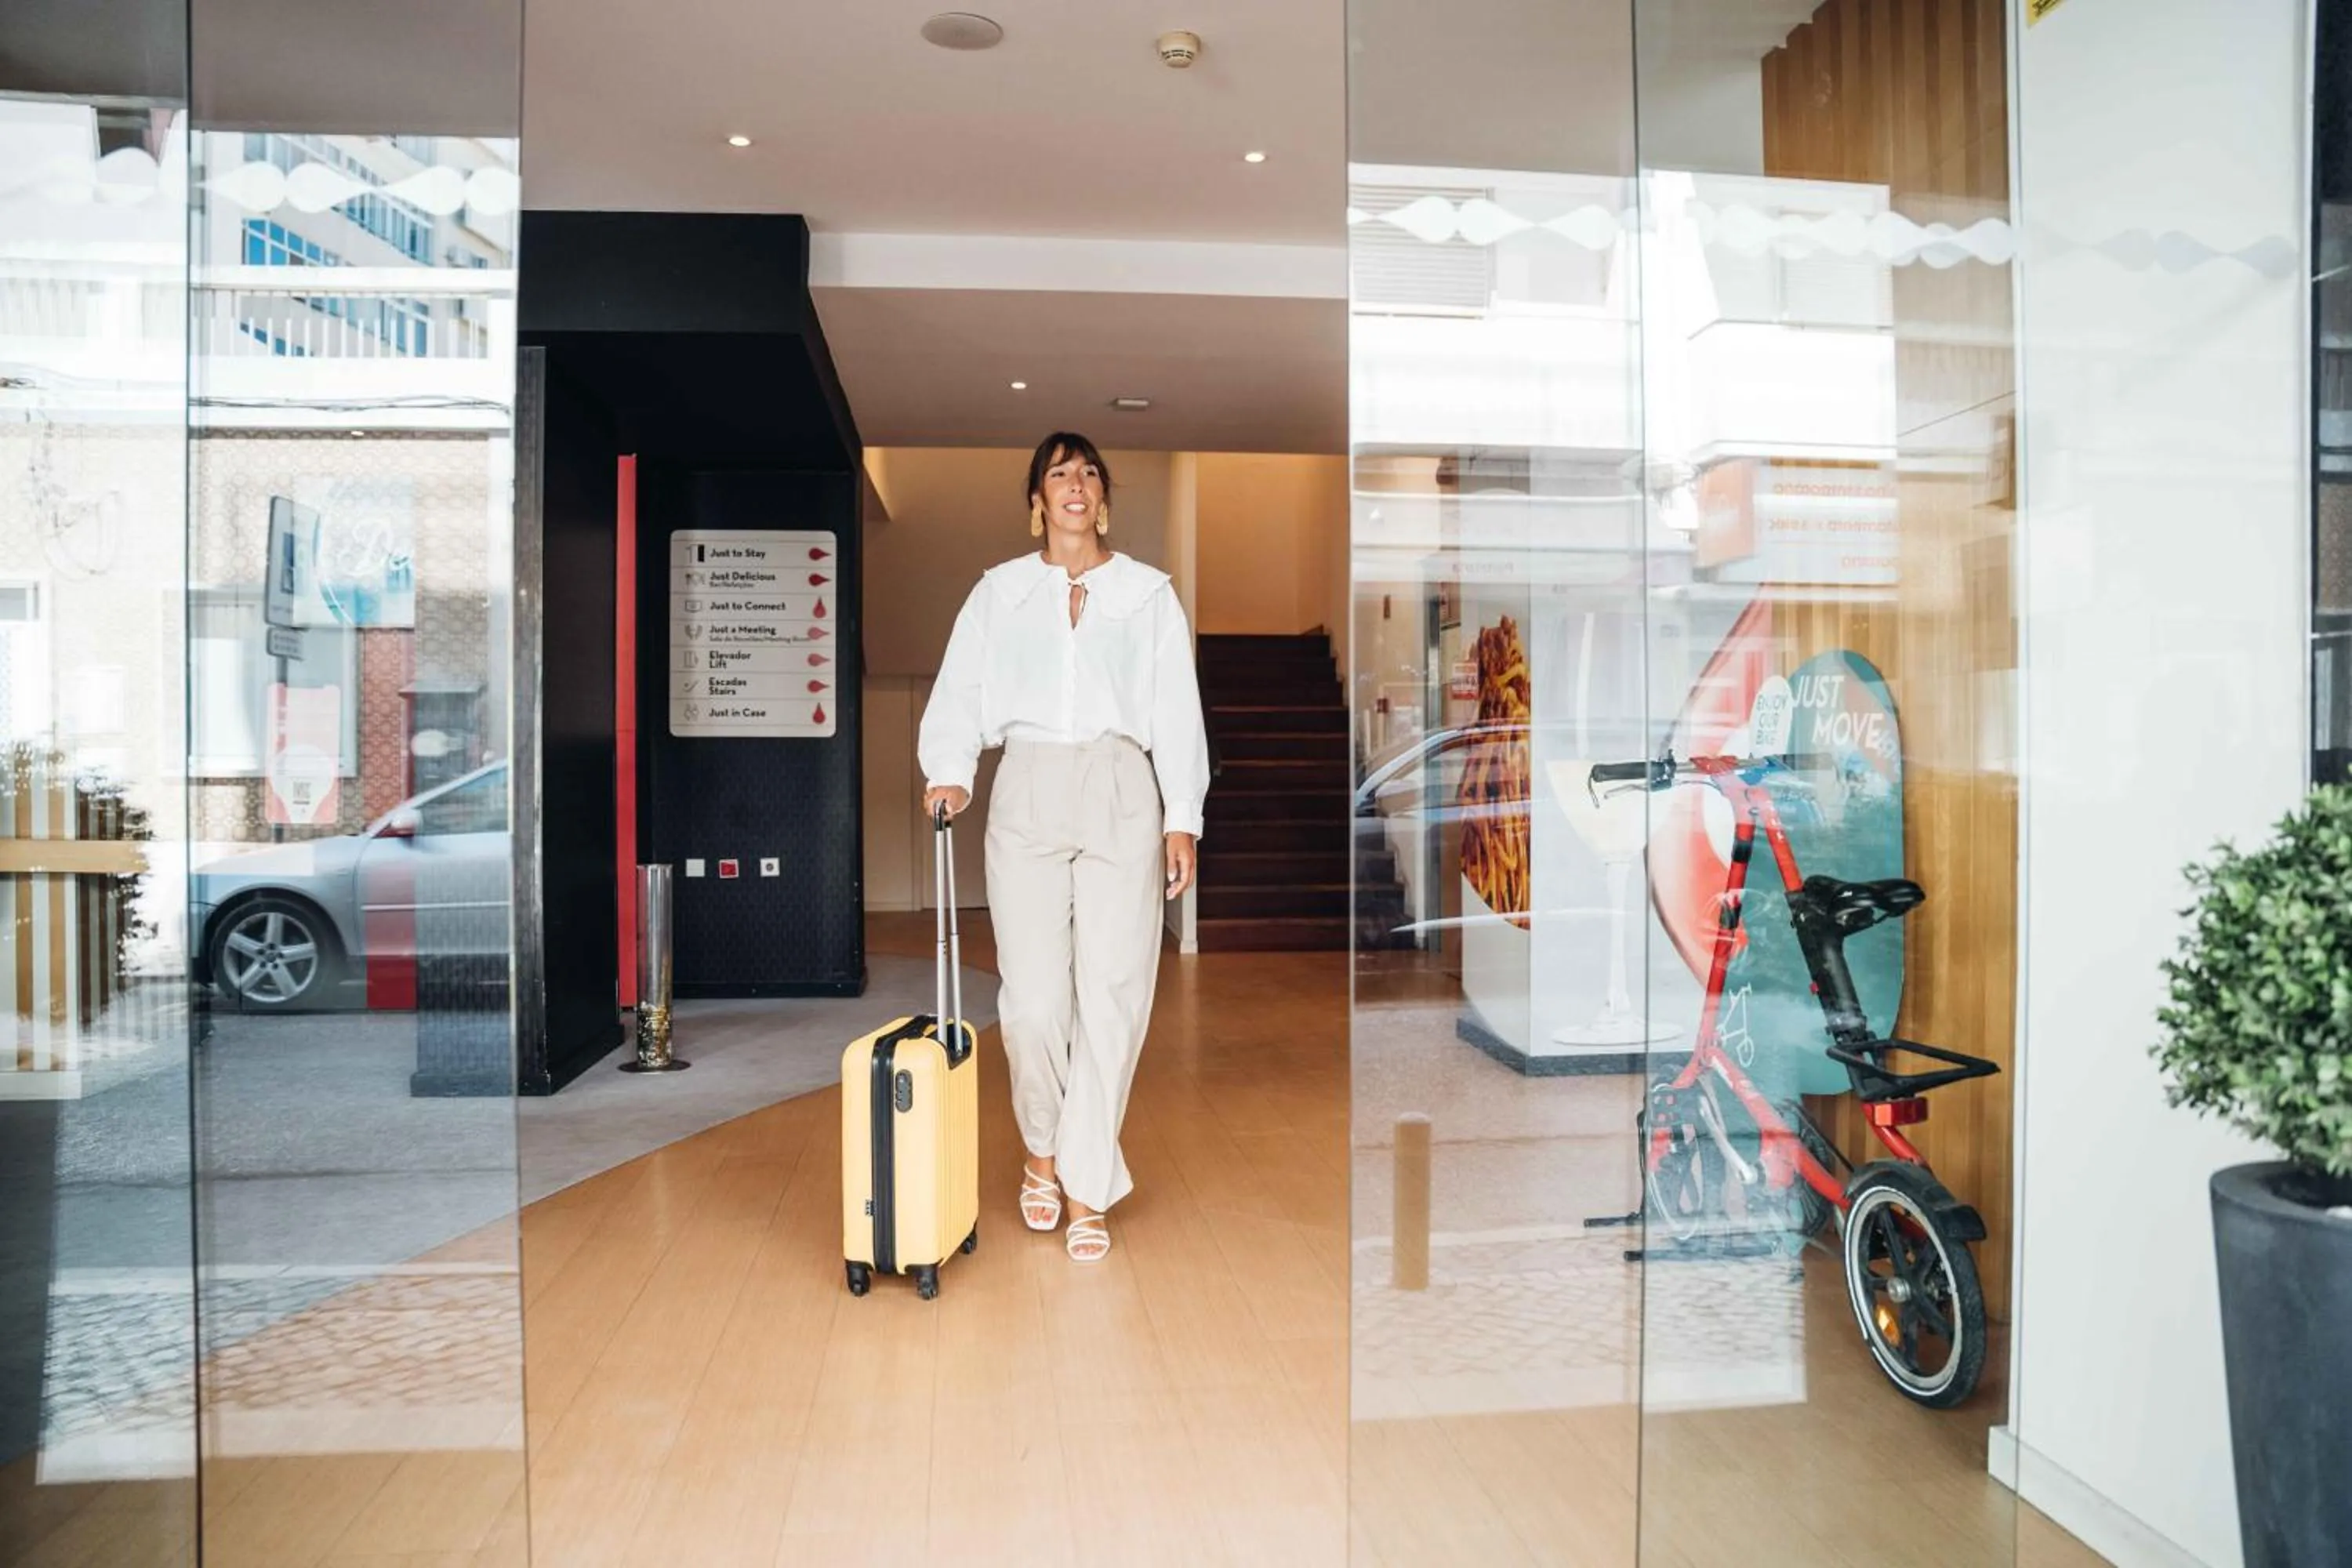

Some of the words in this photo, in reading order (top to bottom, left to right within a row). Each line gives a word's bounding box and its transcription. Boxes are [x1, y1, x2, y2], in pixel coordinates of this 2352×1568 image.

[710, 548, 729, 557] Just
[731, 549, 742, 557] to
[745, 548, 766, 560] Stay
[710, 572, 729, 581] Just
[732, 571, 775, 581] Delicious
[710, 601, 729, 611] Just
[732, 602, 742, 611] to
[745, 601, 786, 611] Connect
[710, 625, 728, 634] Just
[738, 626, 776, 636] Meeting
[709, 650, 751, 659] Elevador
[709, 659, 727, 670] Lift
[709, 677, 747, 686] Escadas
[709, 686, 736, 695] Stairs
[1791, 675, 1845, 709] JUST
[709, 708, 728, 717] Just
[731, 708, 740, 717] in
[742, 708, 766, 717] Case
[1812, 711, 1885, 750] MOVE
